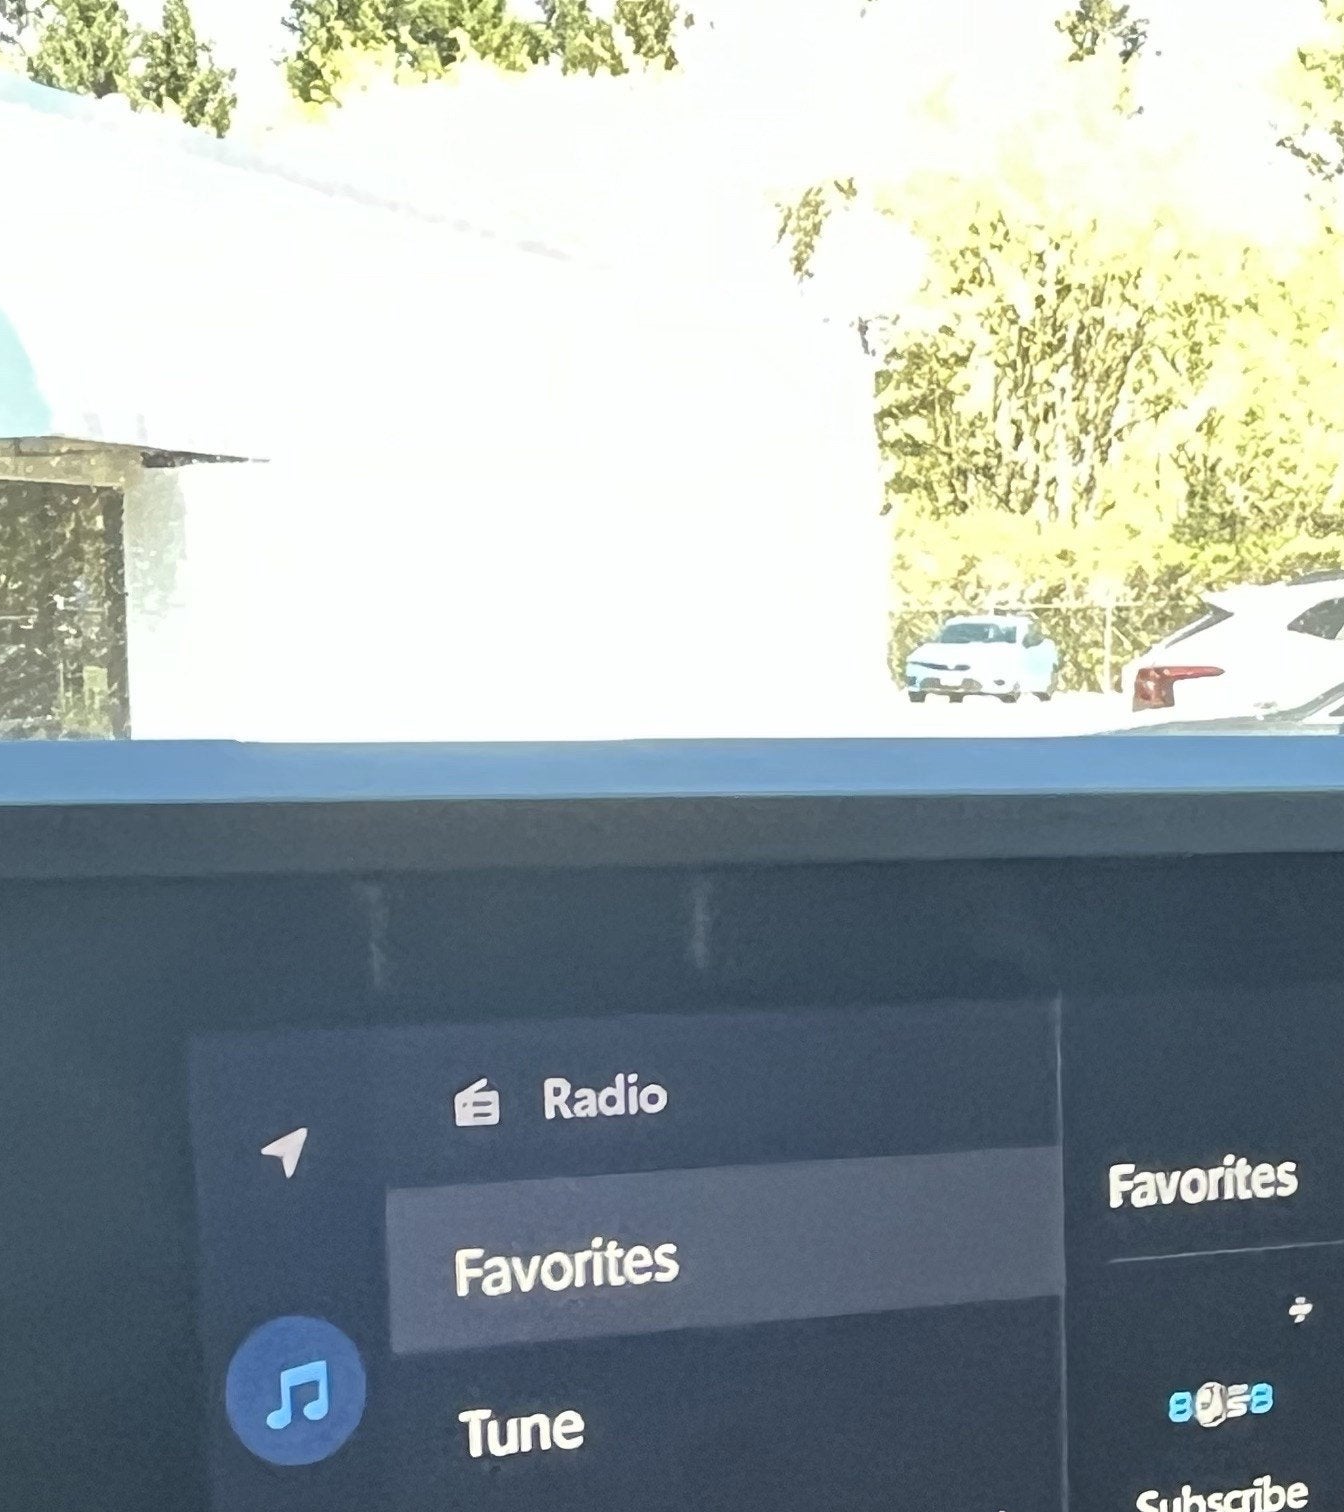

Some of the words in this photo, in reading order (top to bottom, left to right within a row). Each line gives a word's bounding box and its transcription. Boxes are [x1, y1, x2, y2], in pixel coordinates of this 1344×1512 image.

[543, 1073, 668, 1120] Radio
[1108, 1154, 1299, 1209] Favorites
[455, 1236, 680, 1297] Favorites
[458, 1409, 586, 1460] Tune
